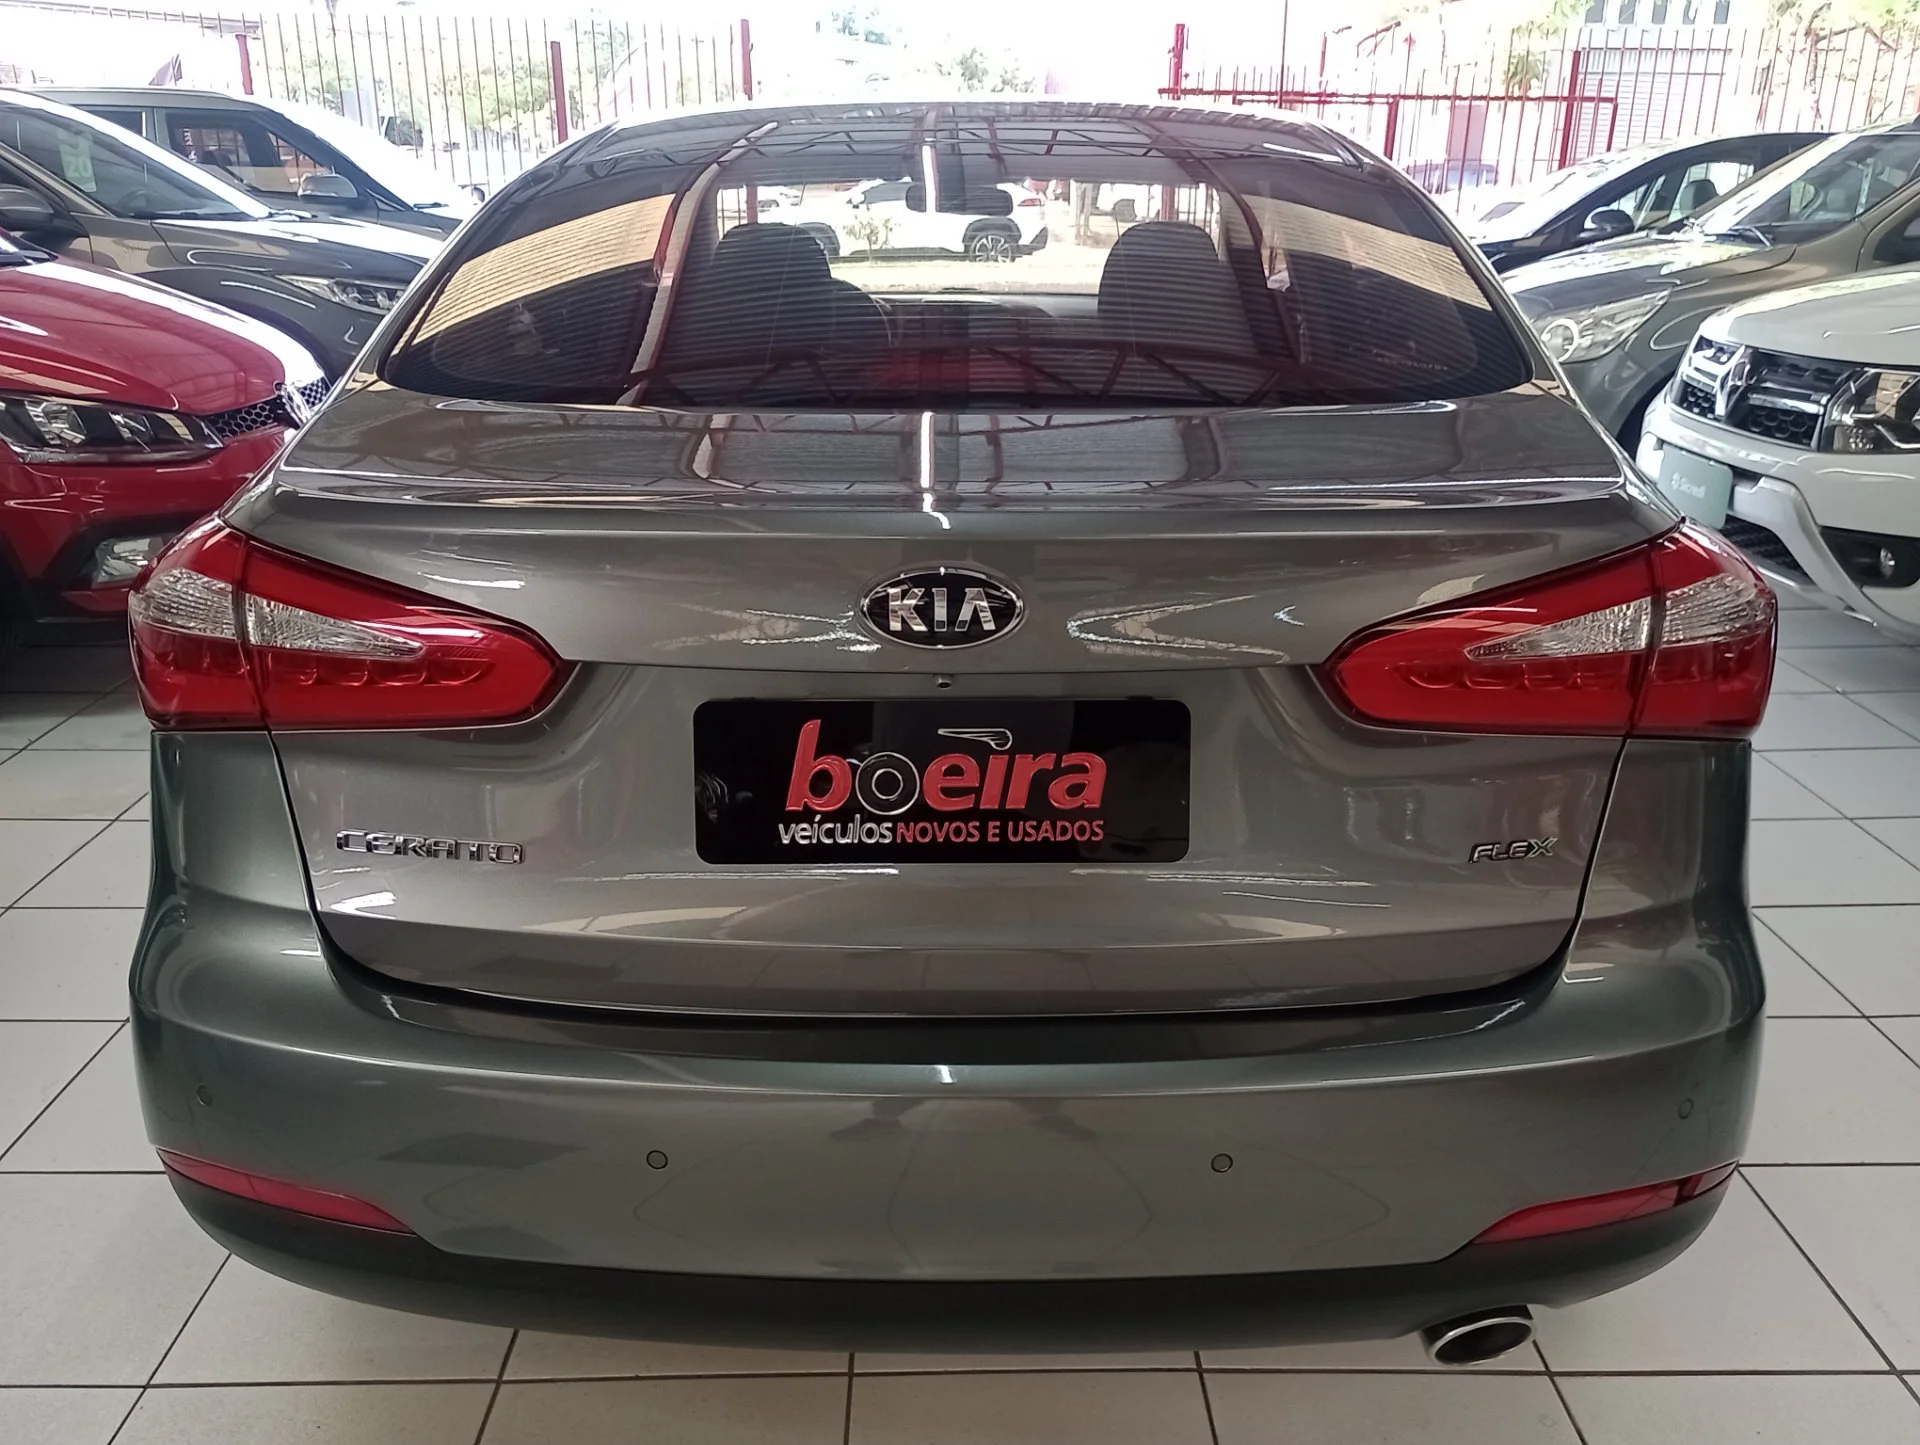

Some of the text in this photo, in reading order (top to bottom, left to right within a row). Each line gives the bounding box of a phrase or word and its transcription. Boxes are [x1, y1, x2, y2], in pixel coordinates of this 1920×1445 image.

[886, 587, 997, 632] KIA
[785, 719, 1107, 816] boeira
[336, 828, 525, 865] CERATO
[778, 813, 1105, 845] veículos NOVOS E USADOS
[1468, 837, 1558, 864] FLEX
